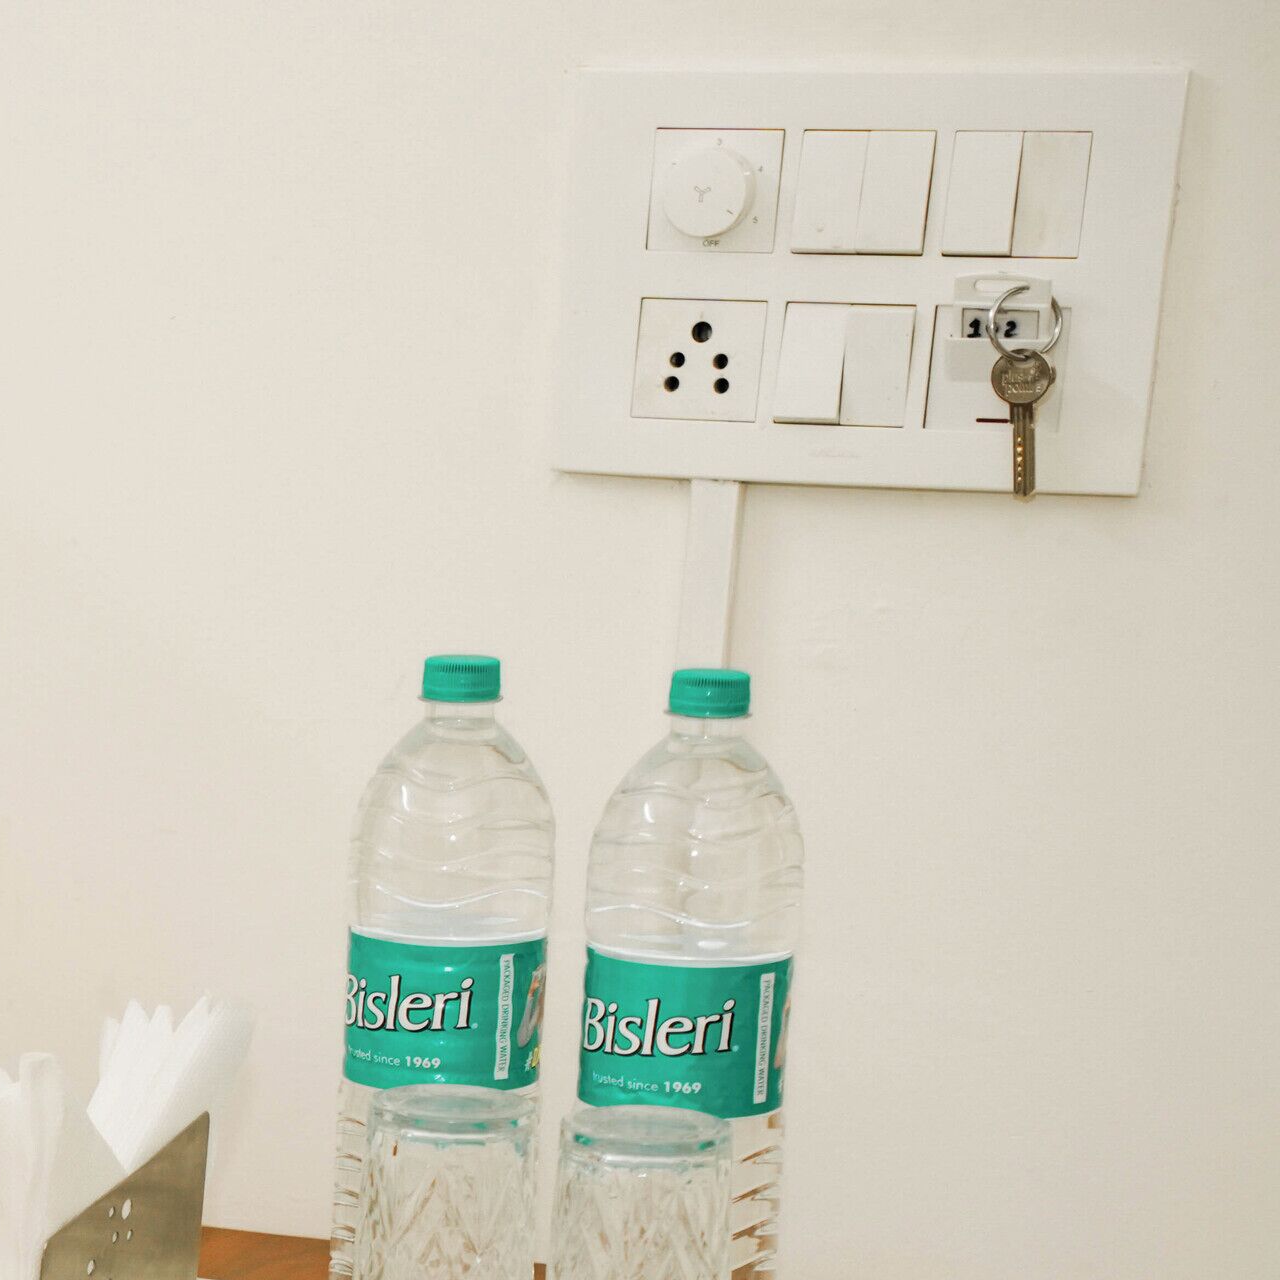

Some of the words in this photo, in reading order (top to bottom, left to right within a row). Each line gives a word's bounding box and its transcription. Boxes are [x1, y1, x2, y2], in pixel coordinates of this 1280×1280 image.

[702, 239, 720, 248] OFF
[501, 960, 511, 1001] PACKAGED
[345, 973, 475, 1032] Bisleri
[761, 979, 771, 1023] PACKAGED
[499, 1004, 510, 1043] DRINKING
[583, 998, 737, 1057] Bisleri
[373, 1051, 400, 1066] since
[405, 1055, 441, 1069] 1969
[497, 1045, 507, 1072] WATER
[758, 1025, 769, 1066] DRINKING
[592, 1070, 625, 1087] trusted
[627, 1078, 659, 1091] since
[664, 1080, 702, 1094] 1969
[757, 1068, 766, 1096] WATER
